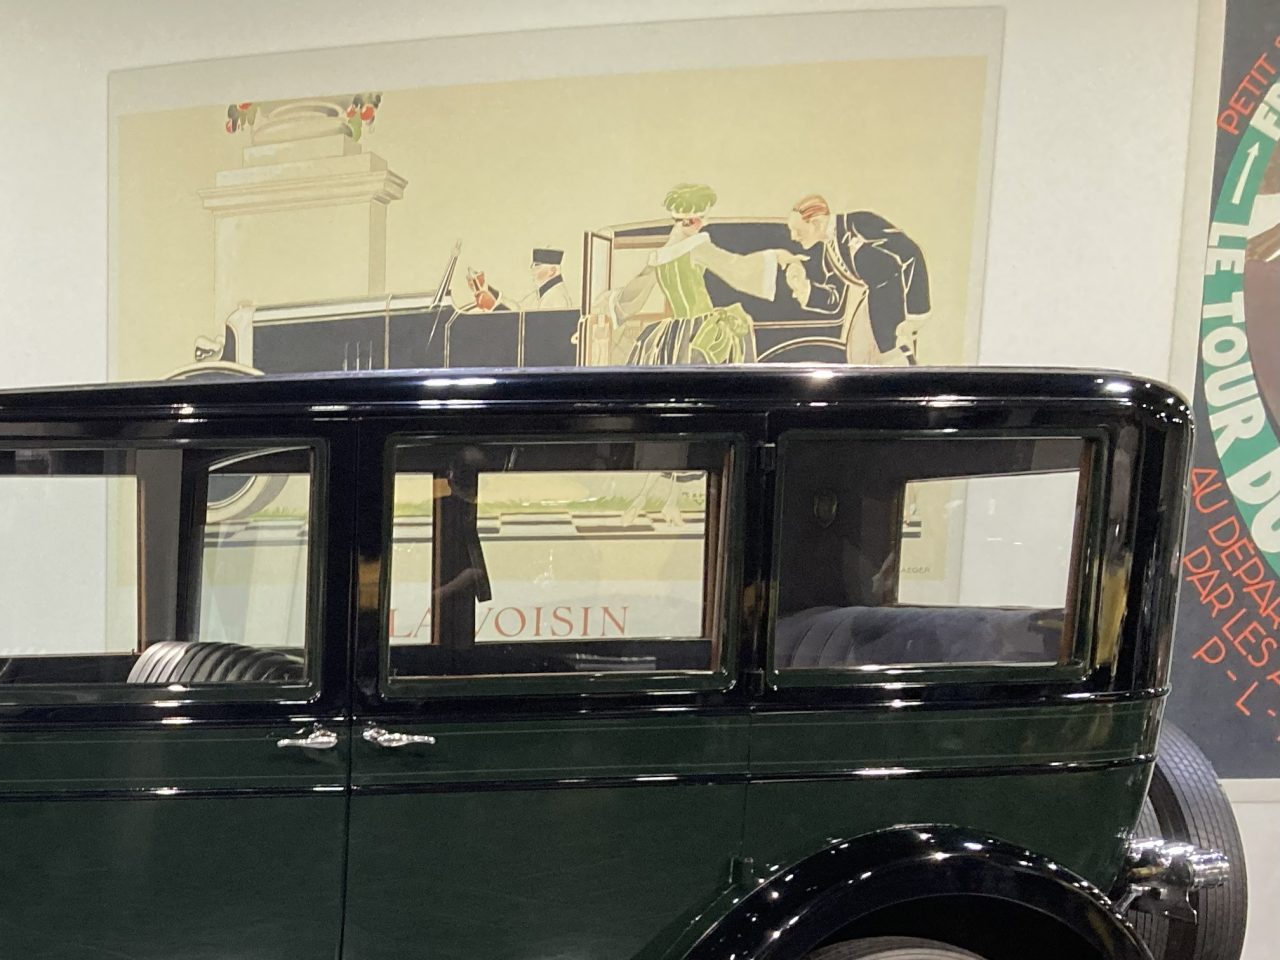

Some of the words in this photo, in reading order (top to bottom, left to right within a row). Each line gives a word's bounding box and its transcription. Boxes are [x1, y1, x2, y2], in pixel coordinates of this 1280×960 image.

[1217, 52, 1277, 136] PETIT
[1204, 222, 1249, 276] LE
[1201, 290, 1267, 461] TOUR
[1191, 467, 1229, 513] AU
[1183, 545, 1235, 618] PAR
[1222, 608, 1278, 667] LES
